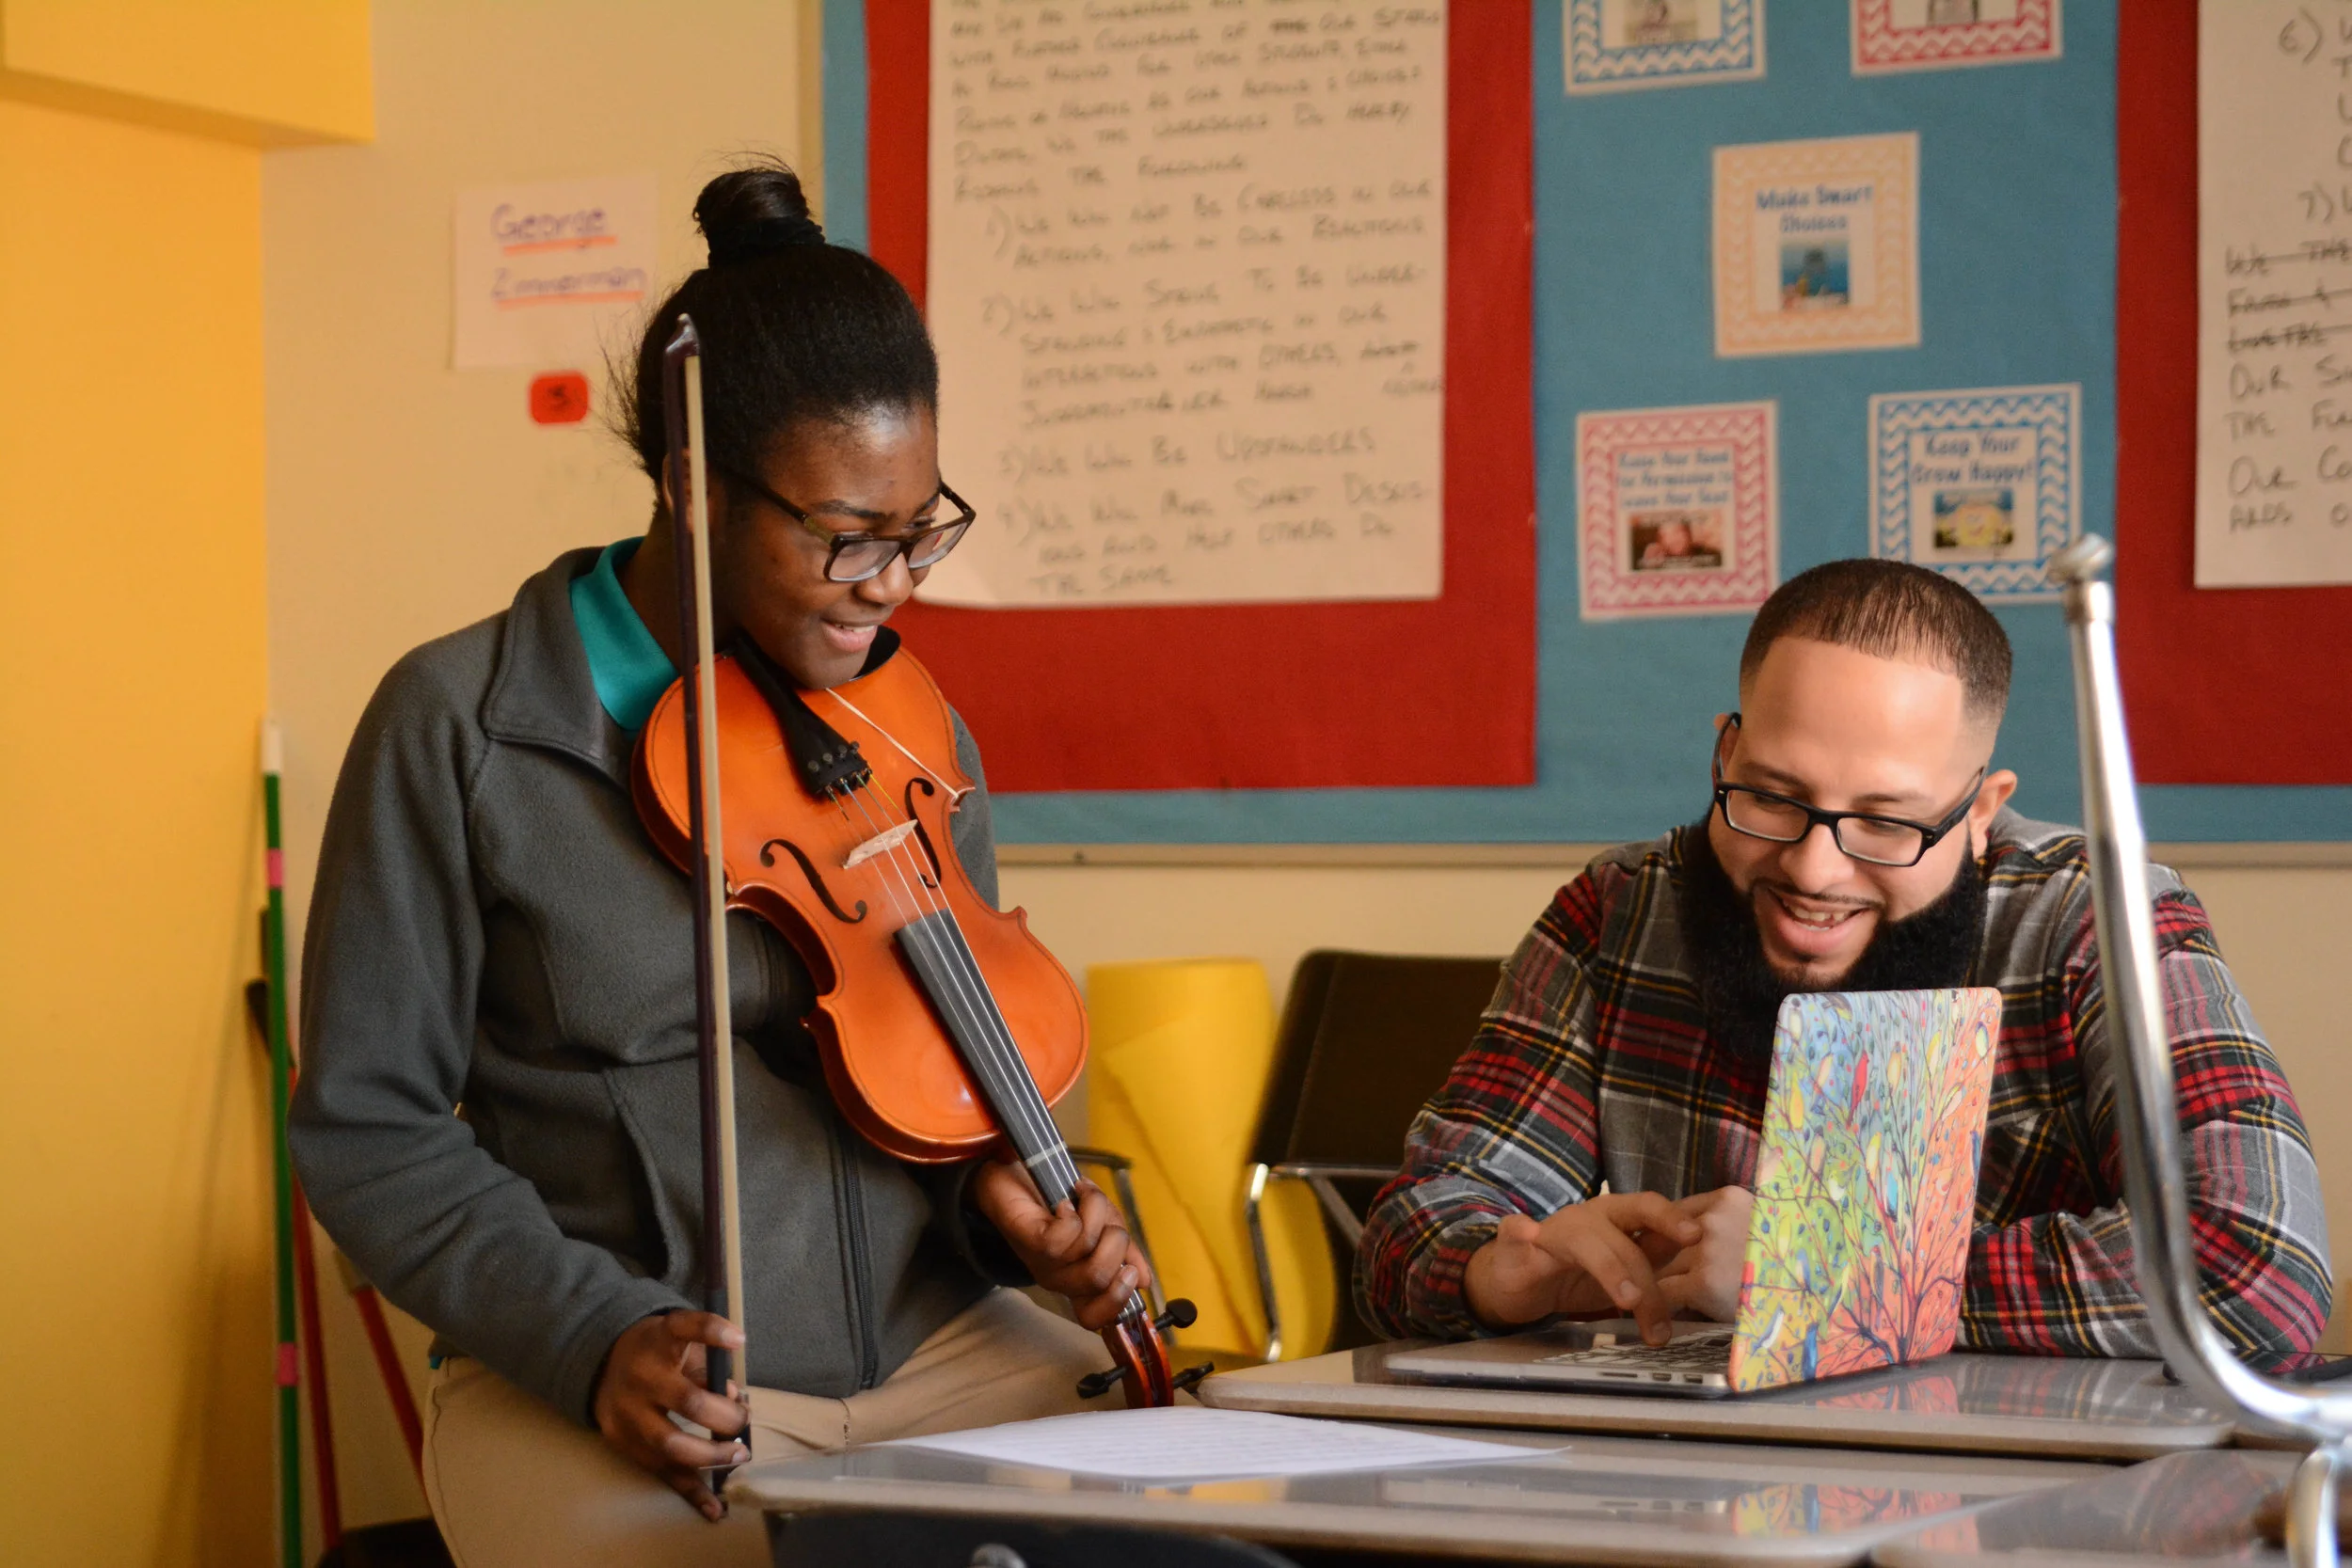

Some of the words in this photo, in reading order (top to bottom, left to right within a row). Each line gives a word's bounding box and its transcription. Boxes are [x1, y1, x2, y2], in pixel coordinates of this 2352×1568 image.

[1756, 187, 1809, 211] Make
[1816, 182, 1873, 206] Smart
[491, 203, 607, 249] George
[1926, 435, 1971, 458] Keep
[1980, 435, 2022, 454] Your
